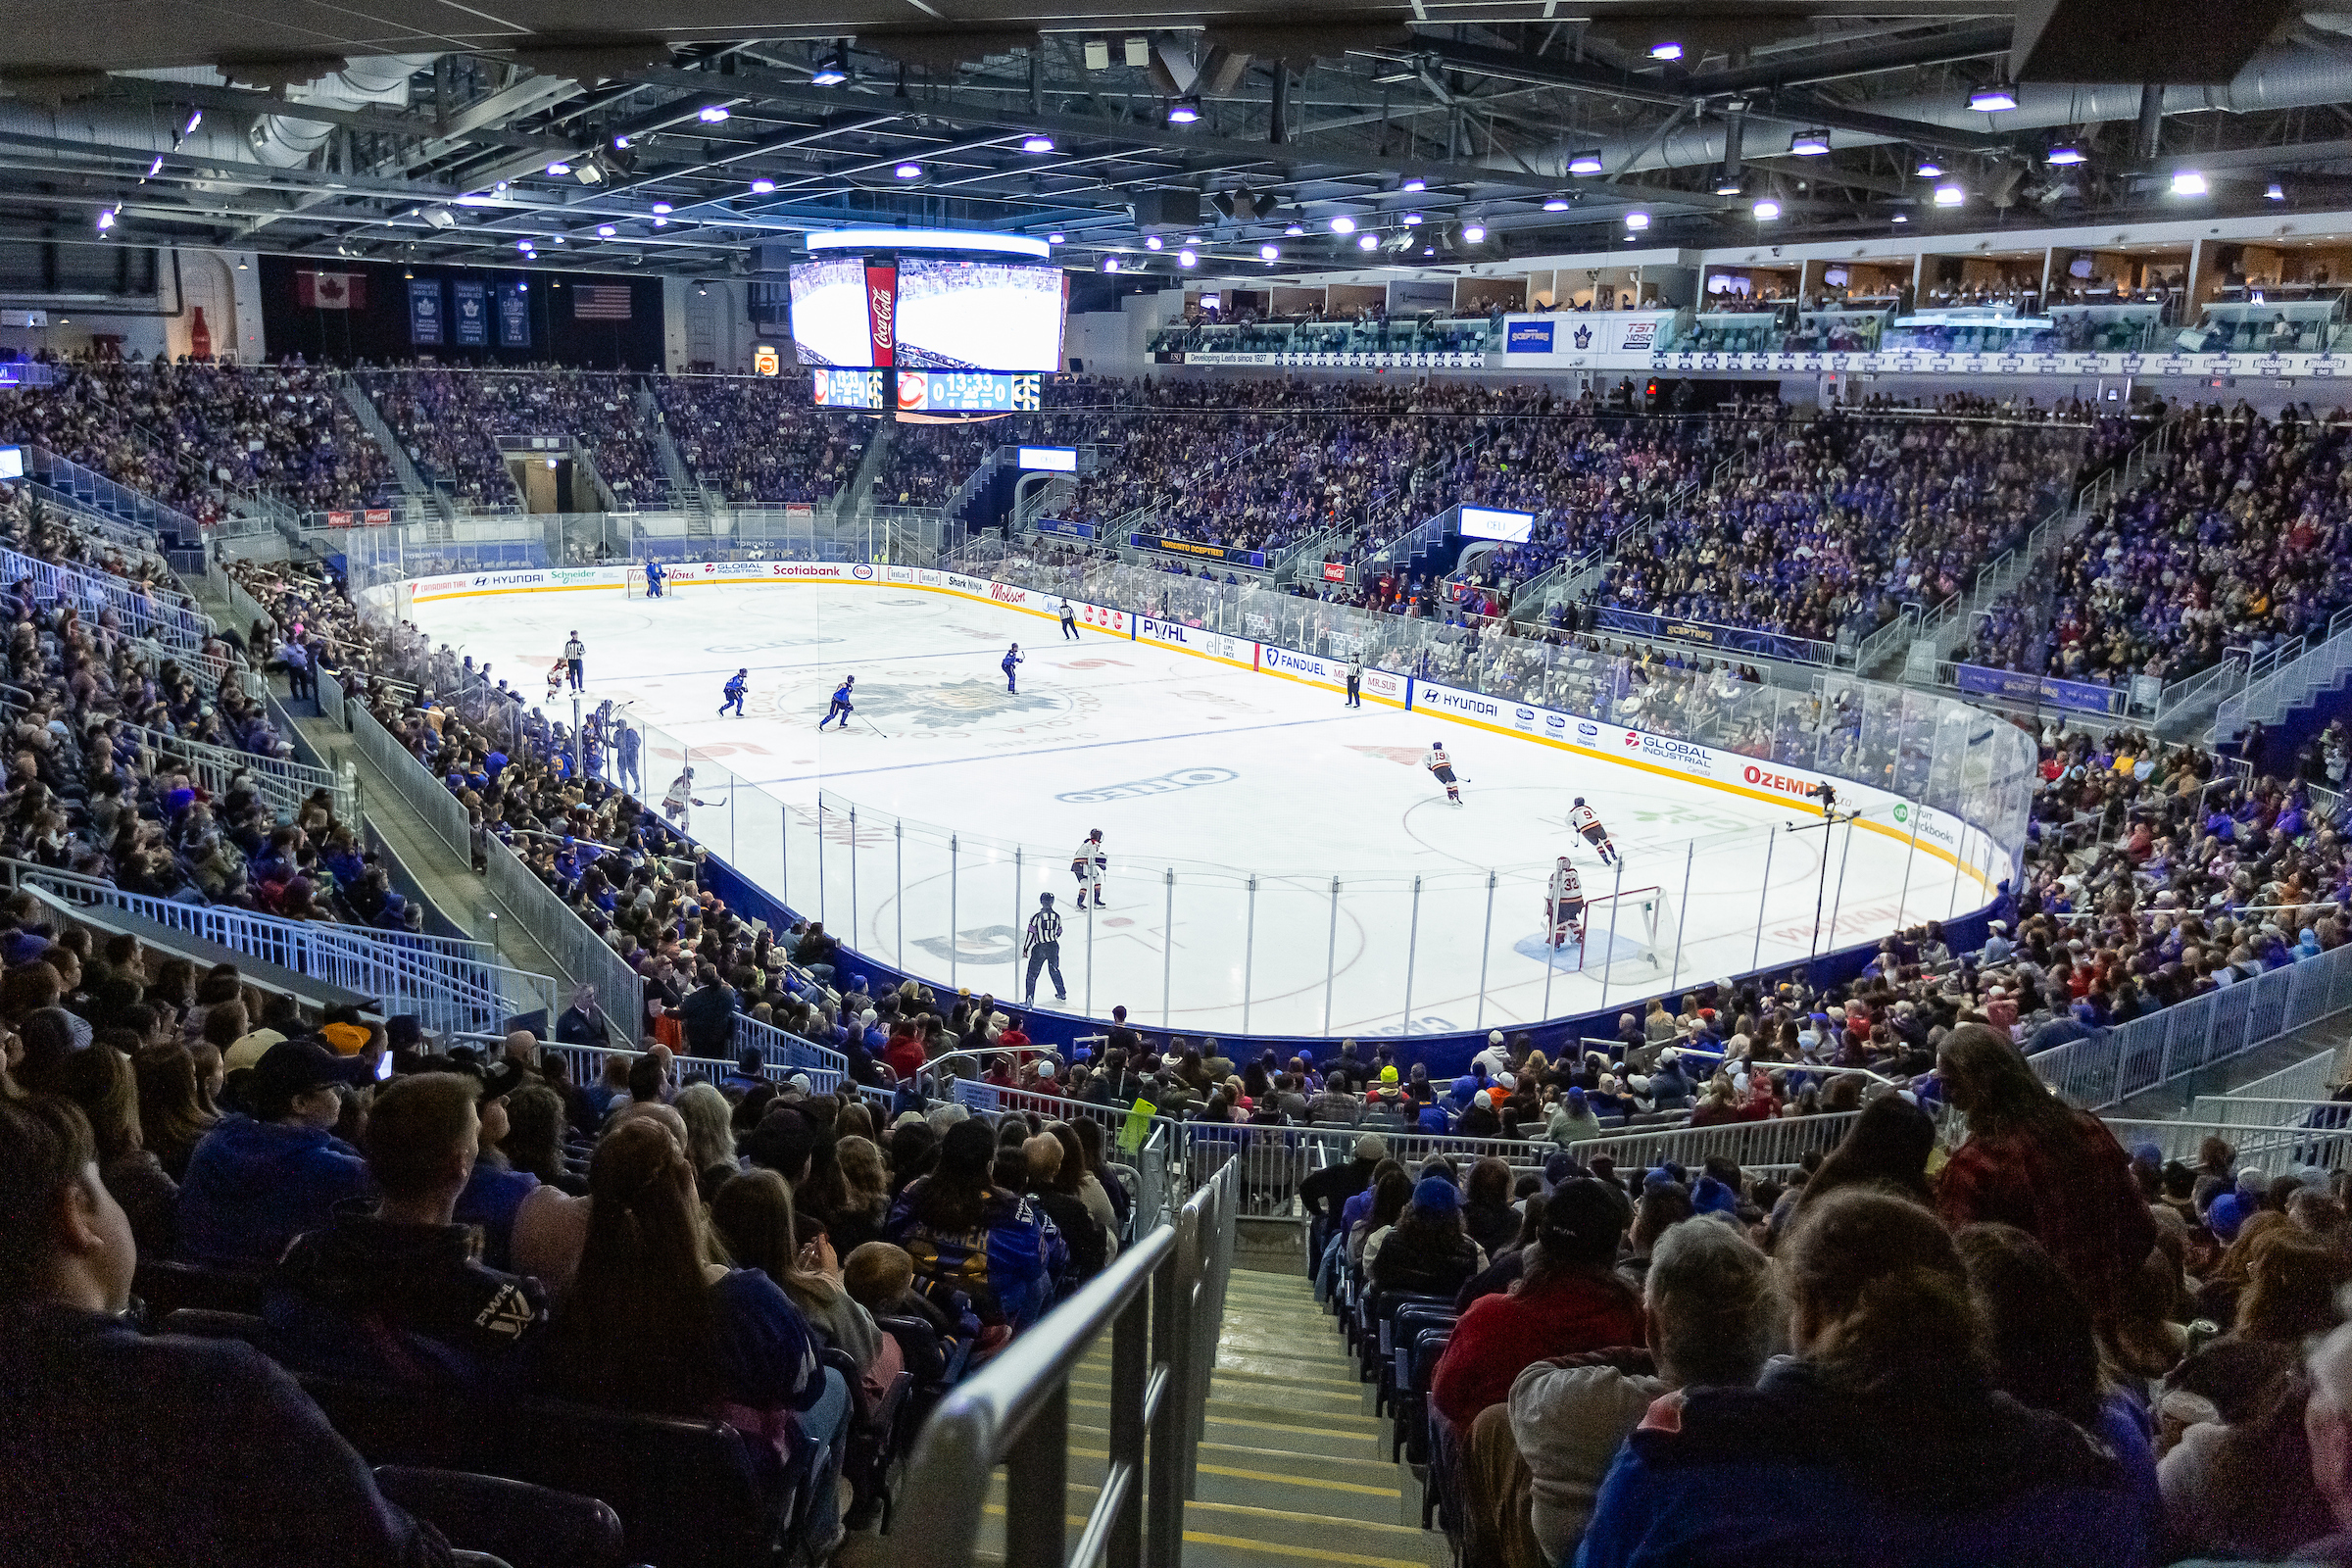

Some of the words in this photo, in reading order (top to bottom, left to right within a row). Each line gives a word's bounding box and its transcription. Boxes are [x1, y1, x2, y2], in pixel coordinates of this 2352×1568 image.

[873, 284, 892, 349] Coca-Cola
[1628, 323, 1657, 333] TSN
[1511, 332, 1549, 342] SCEPTRES
[1191, 354, 1220, 364] Developing
[2255, 360, 2289, 368] HASSARD
[947, 373, 993, 393] 13:33
[933, 383, 944, 402] 0
[995, 384, 1005, 402] 0
[330, 514, 352, 524] Coca-Cola
[368, 512, 389, 522] Coca-Cola
[1161, 540, 1190, 553] TORONTO
[1191, 545, 1224, 558] SCEPTRES
[404, 551, 441, 560] TORONTO
[551, 570, 596, 579] Schneider
[773, 565, 841, 577] Scotiabank
[856, 567, 870, 576] Esso
[890, 569, 911, 579] intact
[921, 571, 940, 582] intact
[1325, 567, 1344, 579] Coca-Cola
[493, 574, 544, 585] HYUNDAI
[420, 582, 452, 593] CANADIAN
[452, 580, 466, 590] TIRE
[990, 583, 1025, 603] Molson
[1144, 619, 1187, 643] PWHL
[1666, 625, 1713, 642] SCEPTRES
[1281, 655, 1326, 676] FANDUEL
[1444, 694, 1497, 717] HYUNDAI
[1515, 722, 1533, 732] Diapers
[1545, 729, 1564, 740] Diapers
[1577, 737, 1596, 748] Diapers
[1643, 736, 1712, 760] GLOBAL
[1434, 752, 1446, 760] 19
[1642, 746, 1711, 768] INDUSTRIAL
[1687, 765, 1711, 777] Canada
[475, 1284, 514, 1327] PWHL
